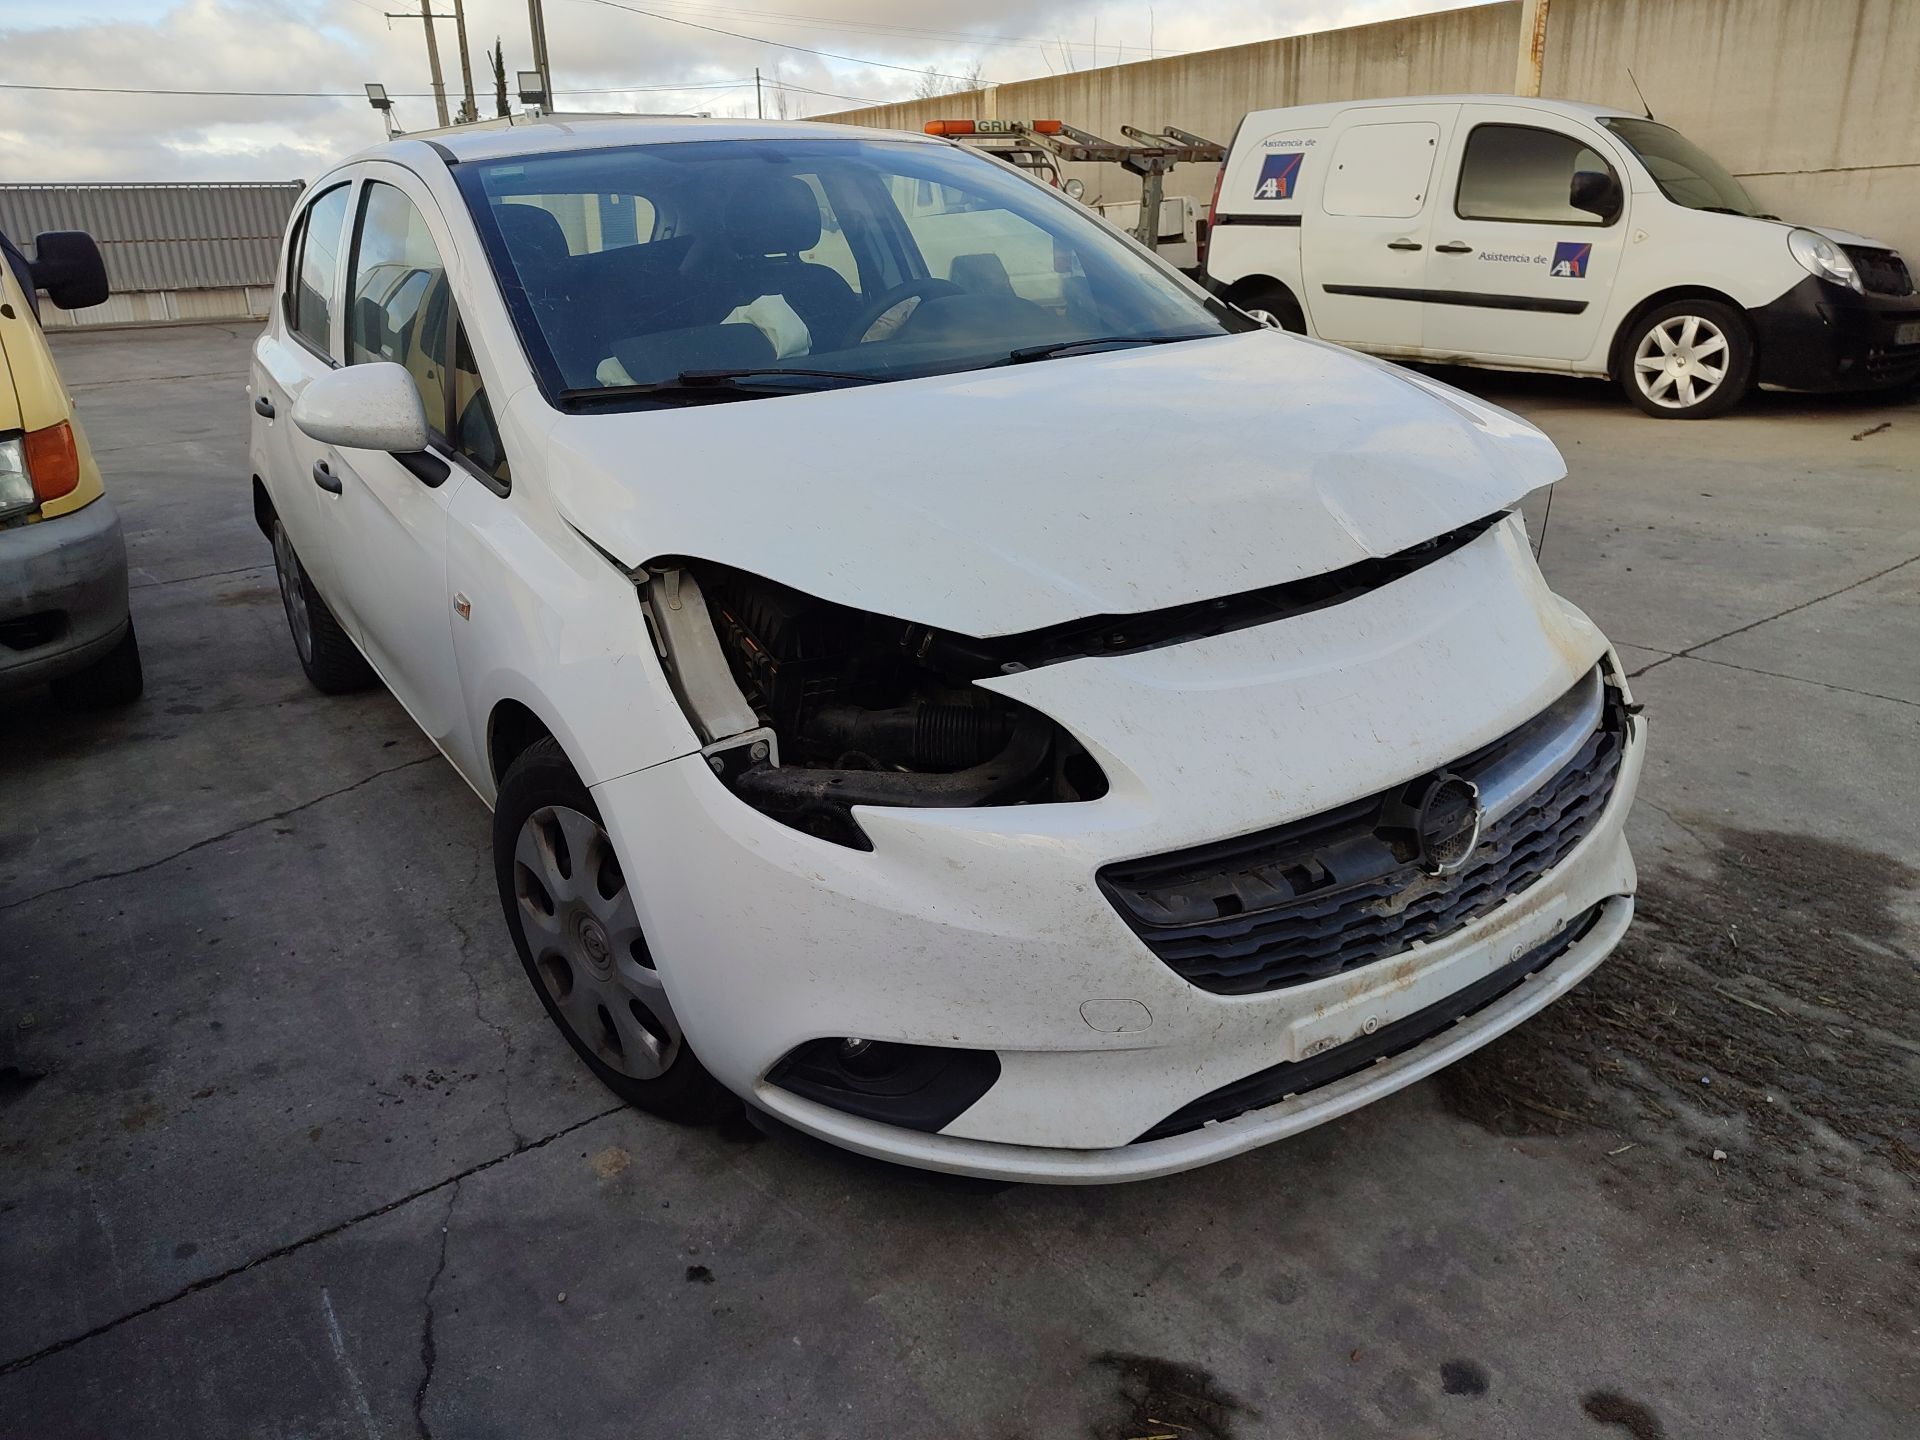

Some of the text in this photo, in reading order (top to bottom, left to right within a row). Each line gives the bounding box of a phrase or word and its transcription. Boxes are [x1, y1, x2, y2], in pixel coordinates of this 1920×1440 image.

[978, 120, 1025, 132] GRU
[1261, 139, 1317, 148] Asistencia de
[1478, 251, 1530, 263] Asistencia
[1533, 254, 1548, 264] de
